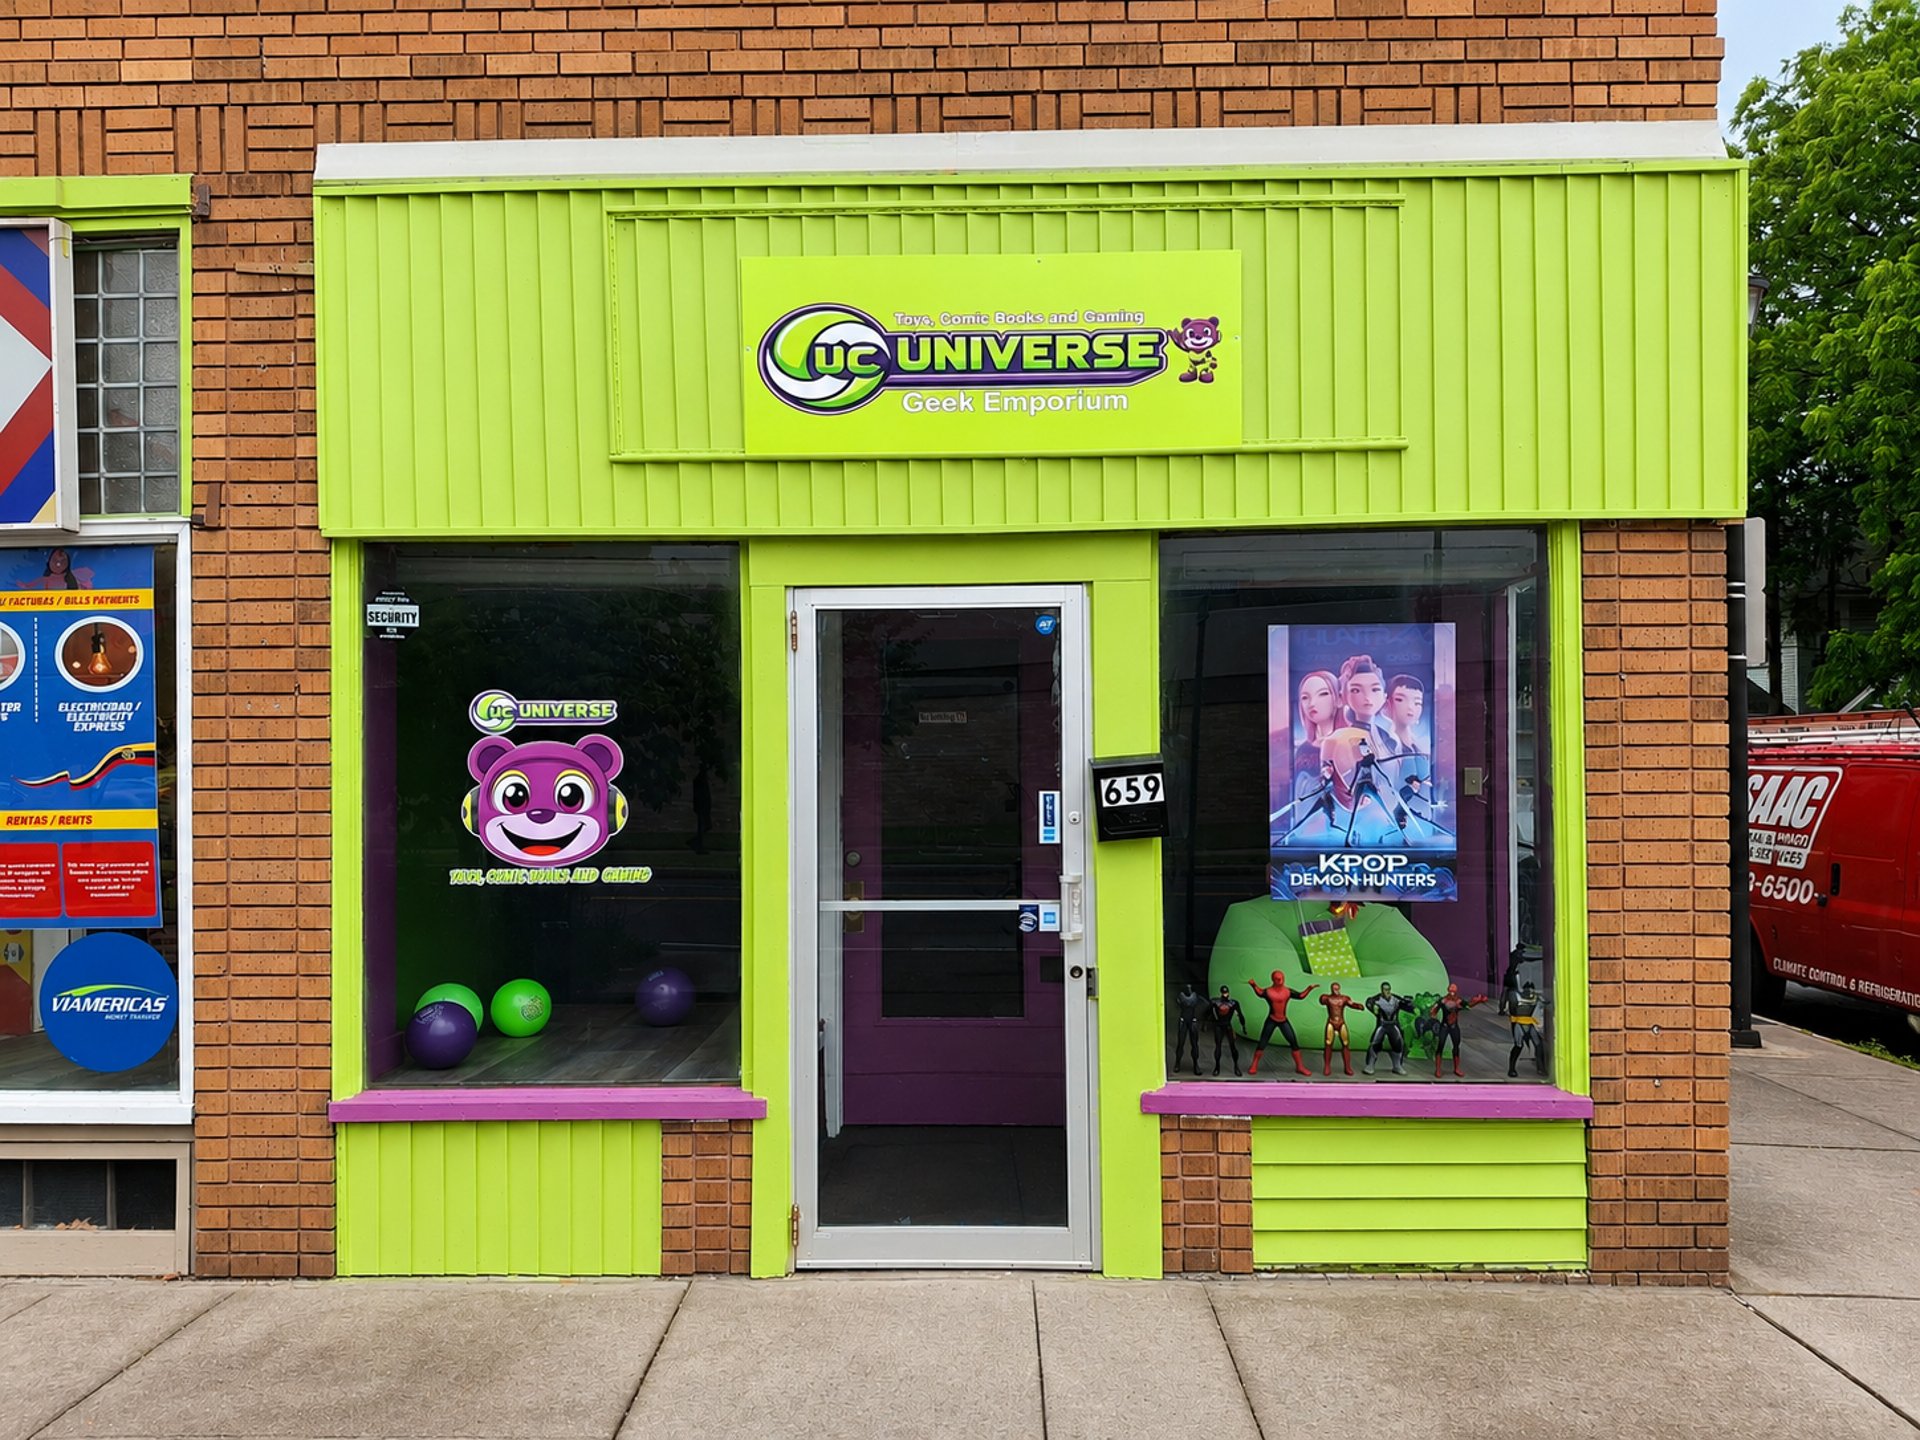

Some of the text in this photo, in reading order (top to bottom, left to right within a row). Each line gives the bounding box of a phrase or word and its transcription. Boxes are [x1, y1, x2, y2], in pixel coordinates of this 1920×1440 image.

[893, 309, 1145, 329] Toys, Comic Books and Gaming
[897, 332, 1160, 372] UNIVERSE
[902, 390, 1129, 417] Geek Emporium
[64, 595, 91, 605] BILLS
[367, 611, 418, 624] SECURITY
[519, 703, 614, 718] UNIVERSE
[73, 721, 126, 732] EXPRESS
[1105, 774, 1161, 806] 659
[6, 815, 48, 826] RENTAS
[58, 815, 94, 826] RENTS
[1319, 853, 1408, 873] KPOP
[1290, 873, 1437, 887] DEMON HUNTERS
[1772, 957, 1808, 979] CLIMATE
[1808, 966, 1848, 990] CONTROL
[52, 997, 167, 1013] VIAMERICAS
